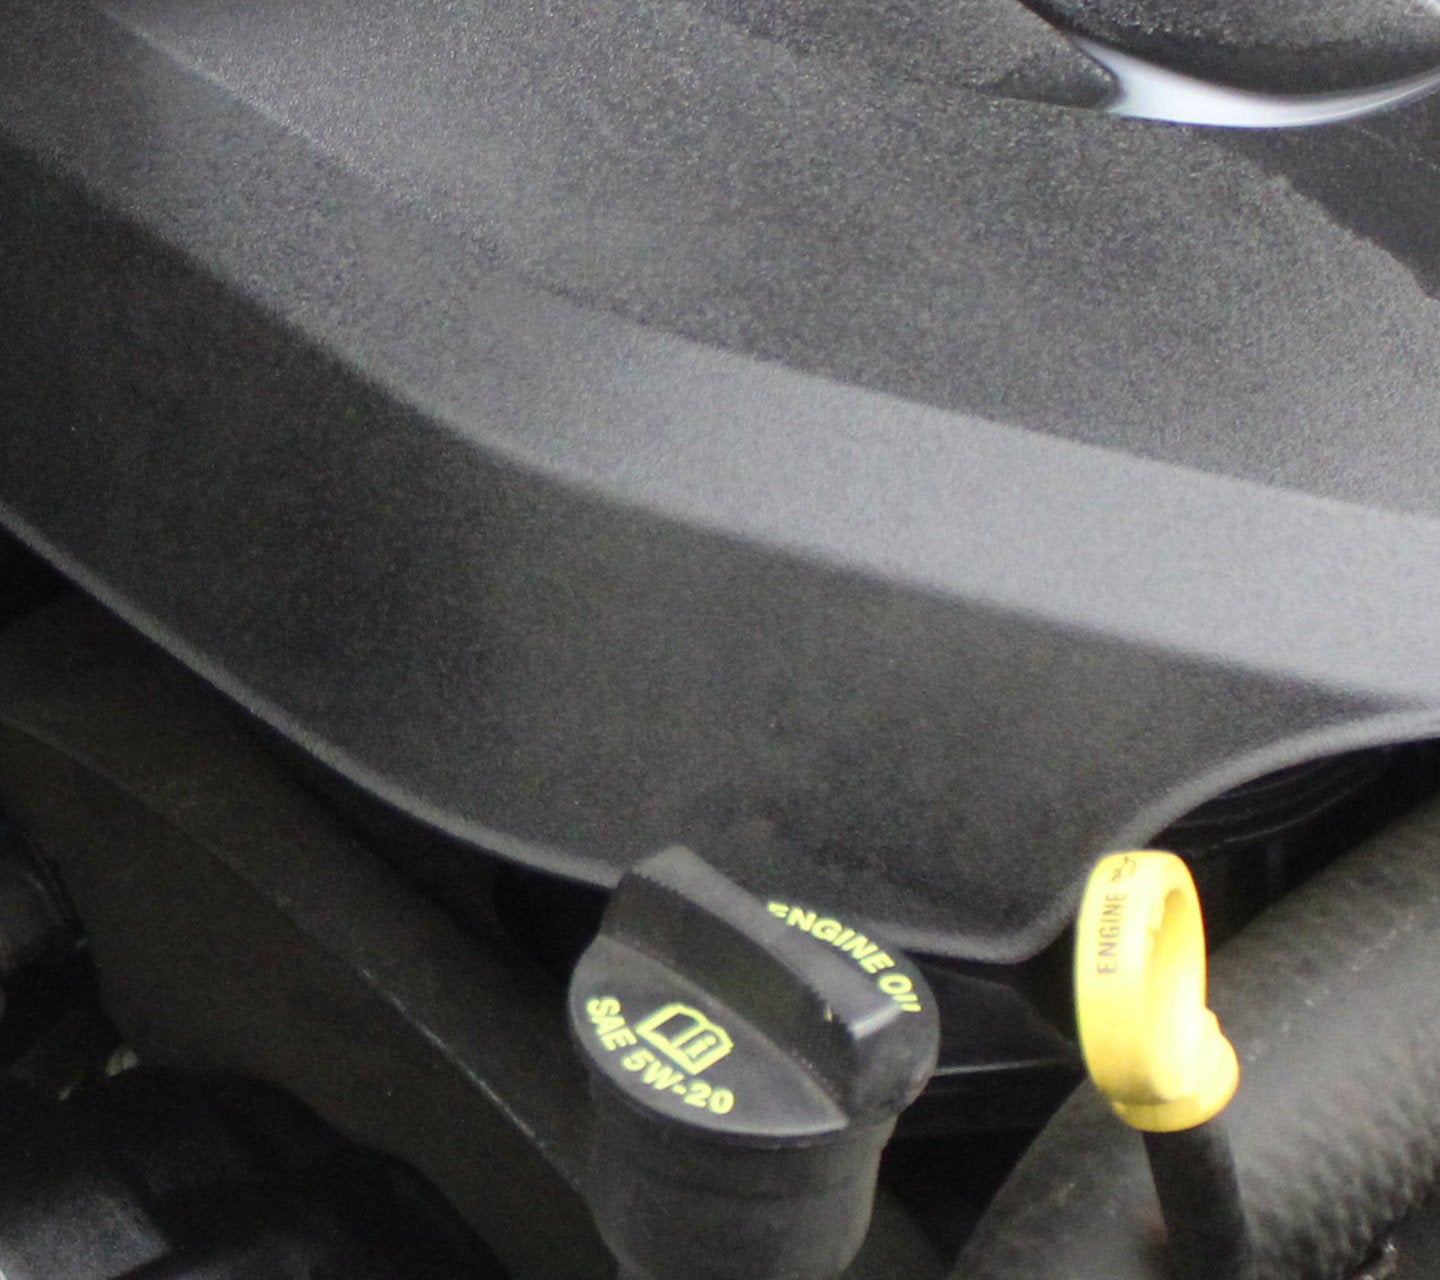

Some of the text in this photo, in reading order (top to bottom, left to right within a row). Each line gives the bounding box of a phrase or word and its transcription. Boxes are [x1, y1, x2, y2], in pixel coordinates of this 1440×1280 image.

[1097, 893, 1127, 974] ENGINE
[585, 995, 735, 1115] SAE 5W-20
